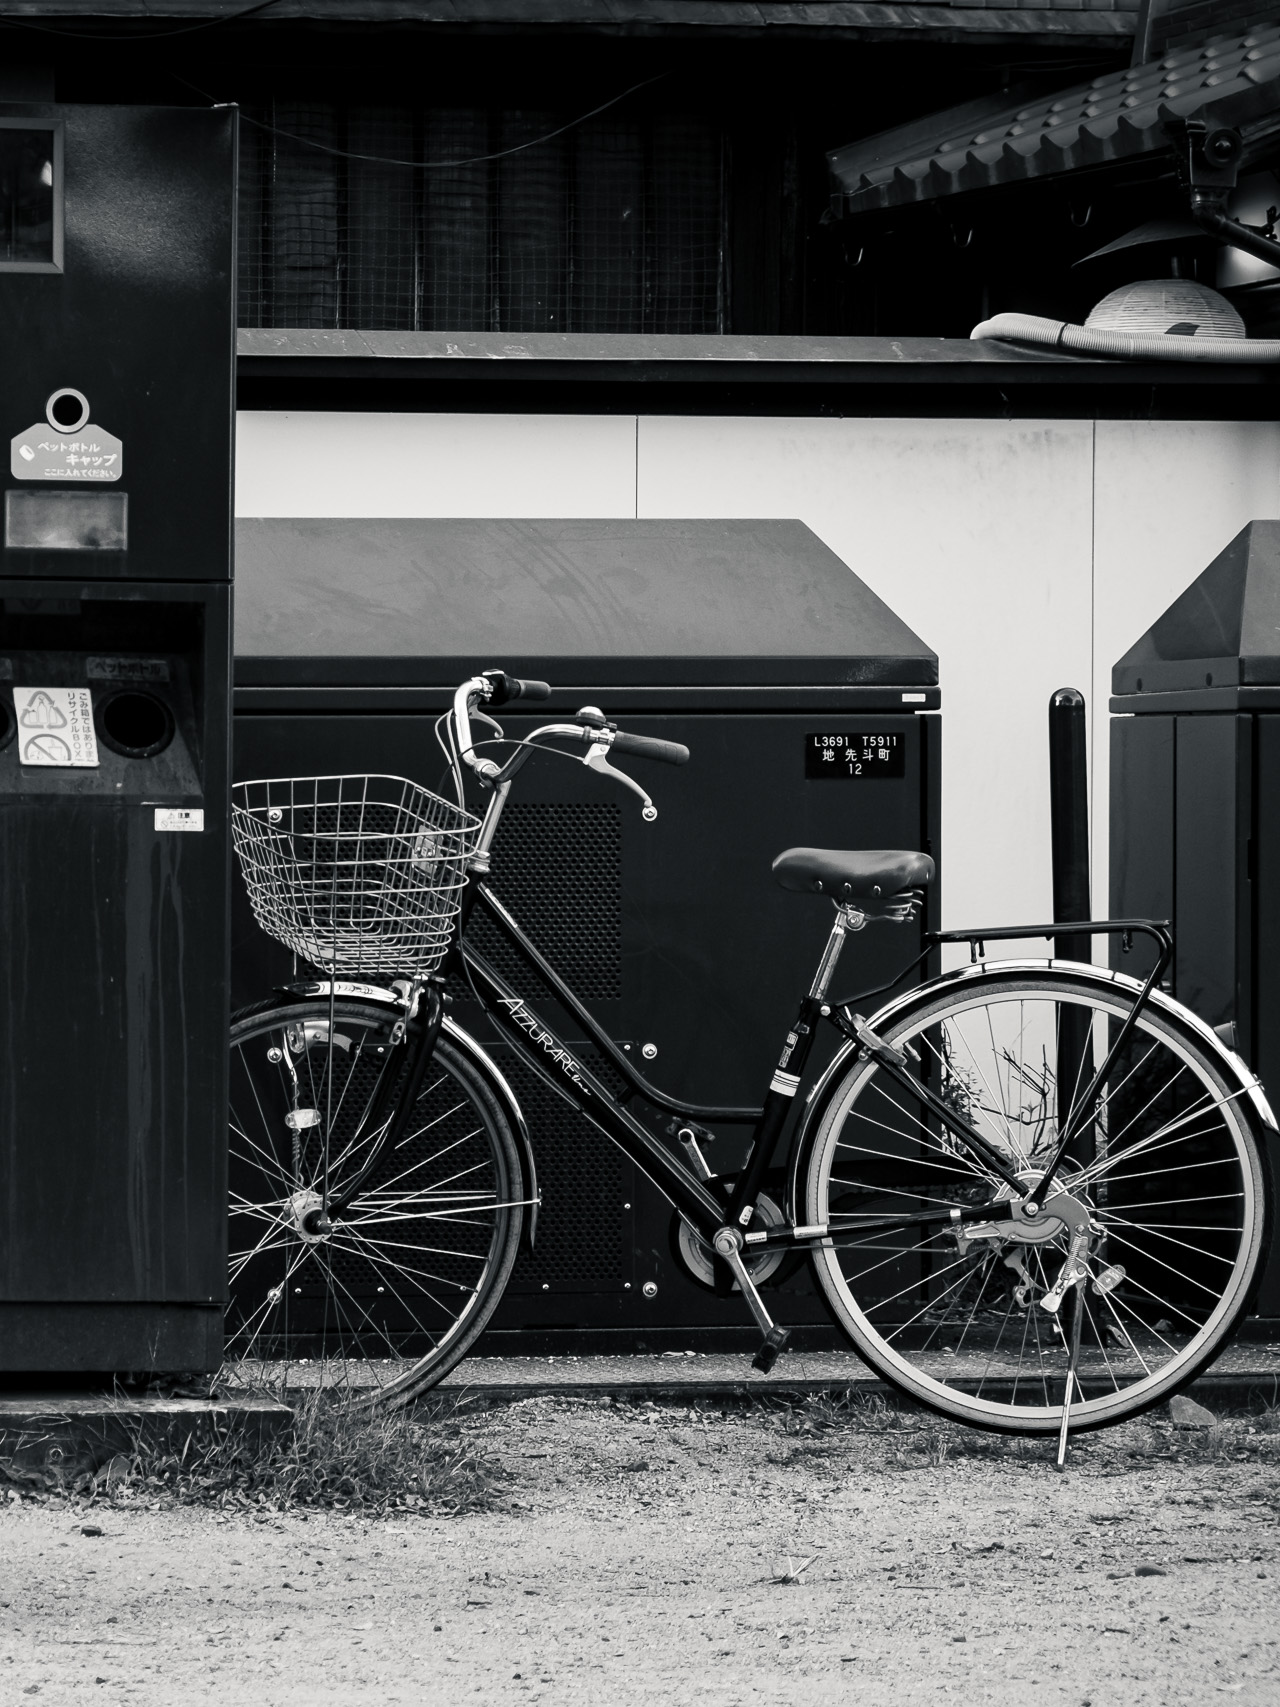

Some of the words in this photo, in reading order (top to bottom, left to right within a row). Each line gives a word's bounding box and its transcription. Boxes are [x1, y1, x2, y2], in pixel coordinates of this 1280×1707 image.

[38, 442, 100, 453] ペットボトル
[66, 454, 118, 466] キャップ
[814, 736, 849, 747] L3691
[862, 736, 897, 747] T5911
[822, 749, 835, 761] 地
[849, 763, 862, 775] 12
[497, 999, 580, 1077] AZZURARE
